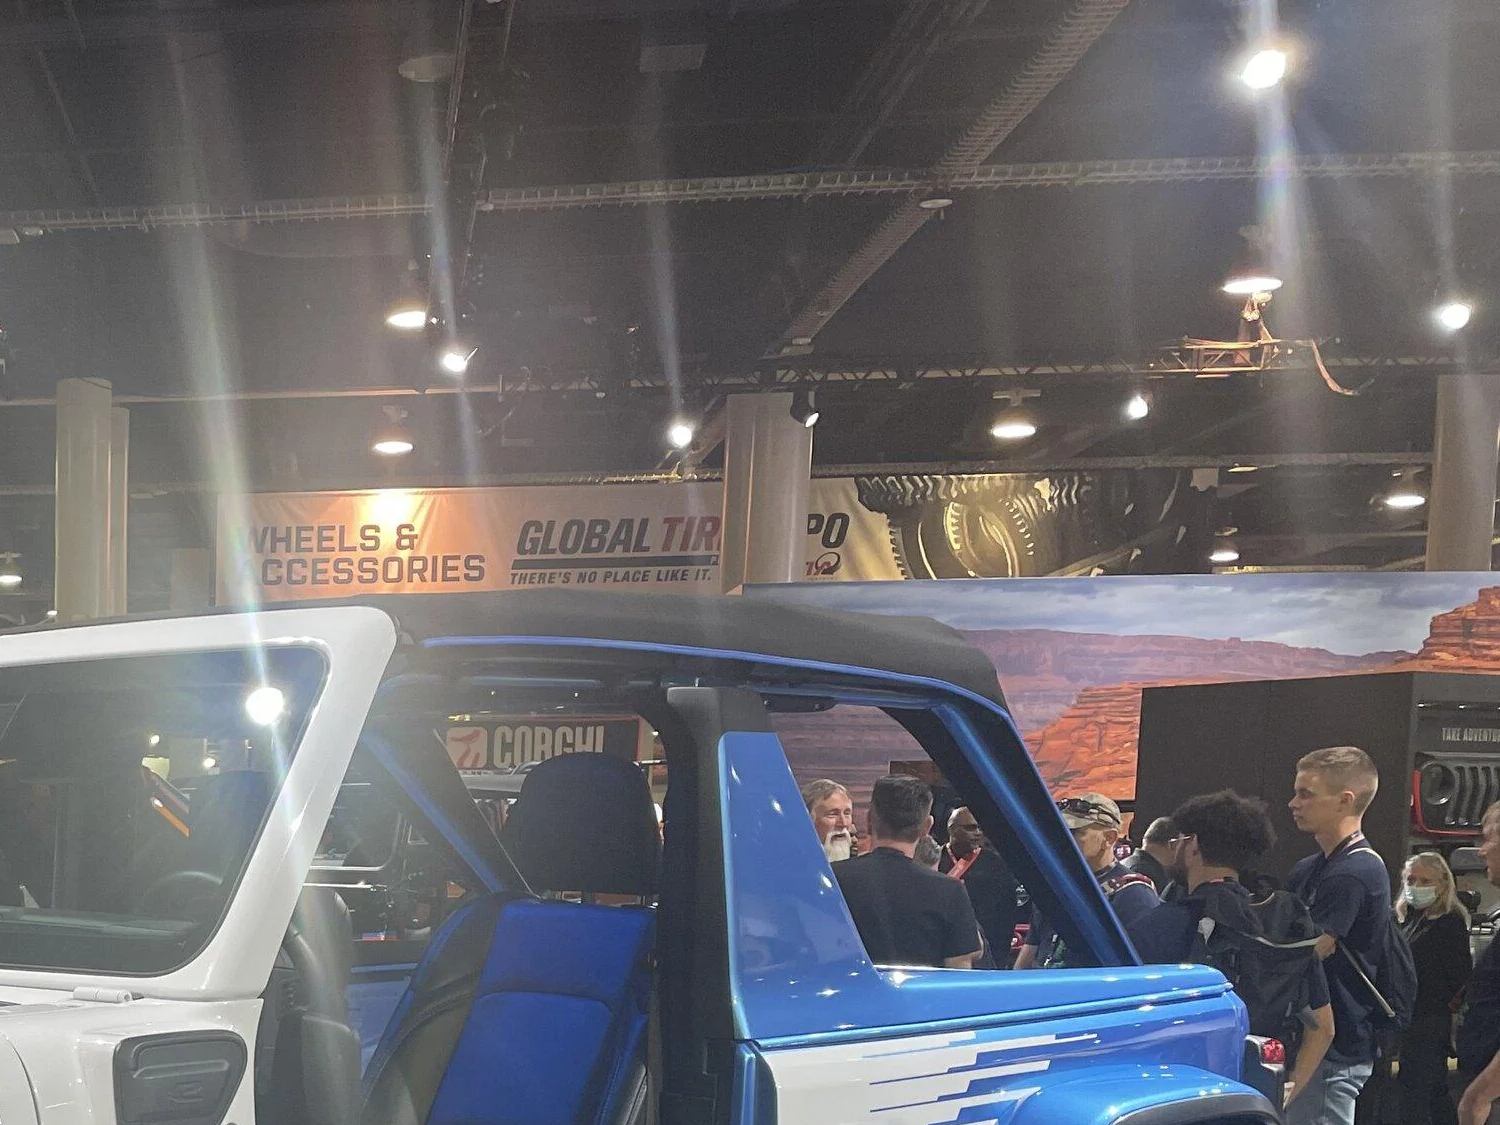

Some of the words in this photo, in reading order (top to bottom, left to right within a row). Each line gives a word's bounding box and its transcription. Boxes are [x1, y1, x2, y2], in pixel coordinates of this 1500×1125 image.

[396, 523, 419, 551] &
[516, 517, 652, 556] GLOBAL
[660, 515, 722, 553] TIR
[261, 554, 486, 586] CCESSORIES
[510, 571, 572, 585] THERE'S
[577, 571, 598, 584] NO
[602, 569, 650, 583] PLACE
[655, 568, 689, 582] LIKE
[694, 567, 712, 582] IT.
